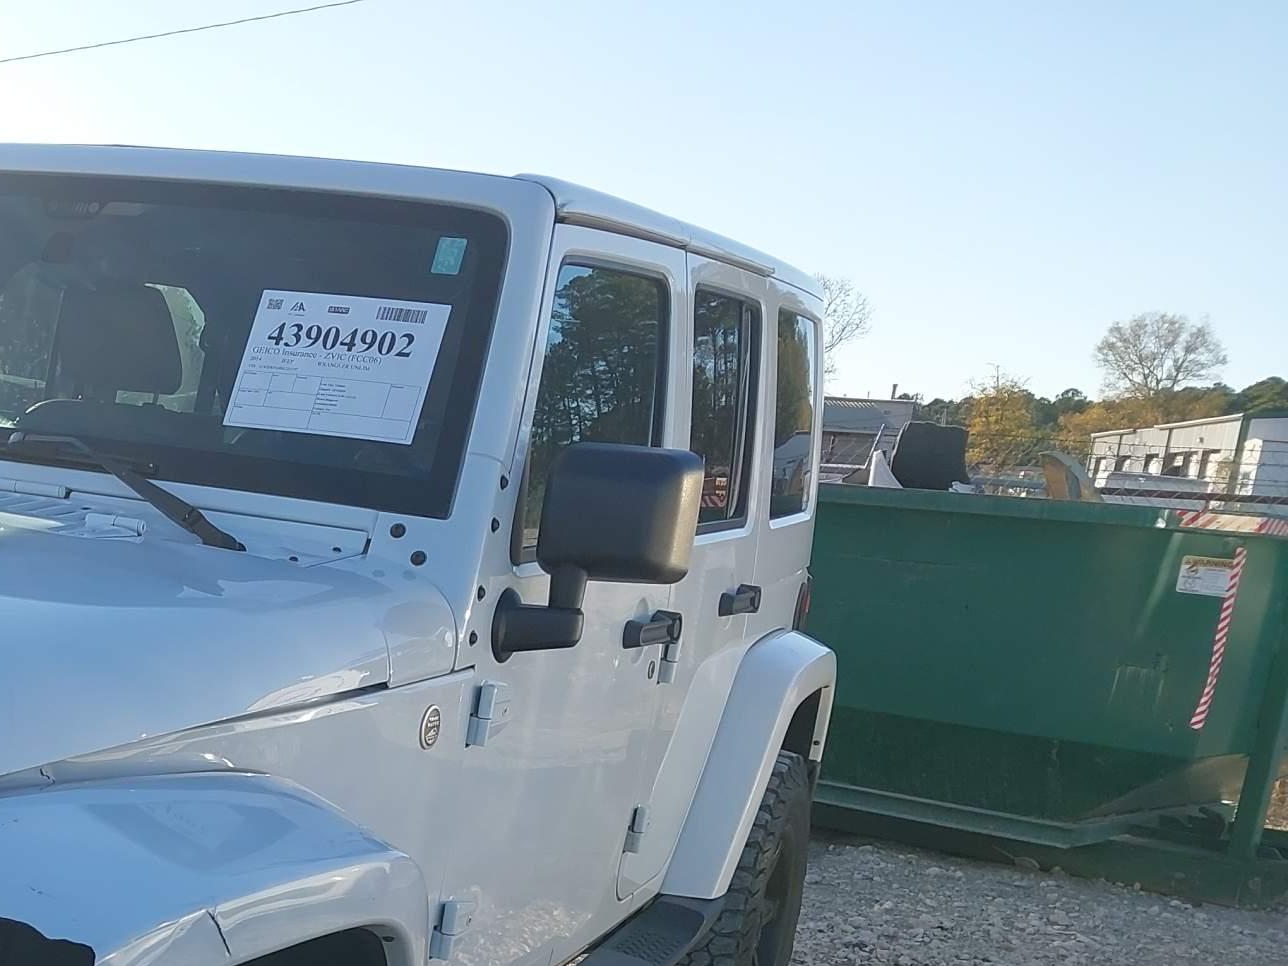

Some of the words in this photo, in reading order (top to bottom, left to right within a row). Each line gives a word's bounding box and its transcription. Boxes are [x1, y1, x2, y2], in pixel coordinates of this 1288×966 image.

[267, 322, 415, 358] 43904902
[252, 346, 280, 355] GEICO
[282, 349, 317, 359] Insurance
